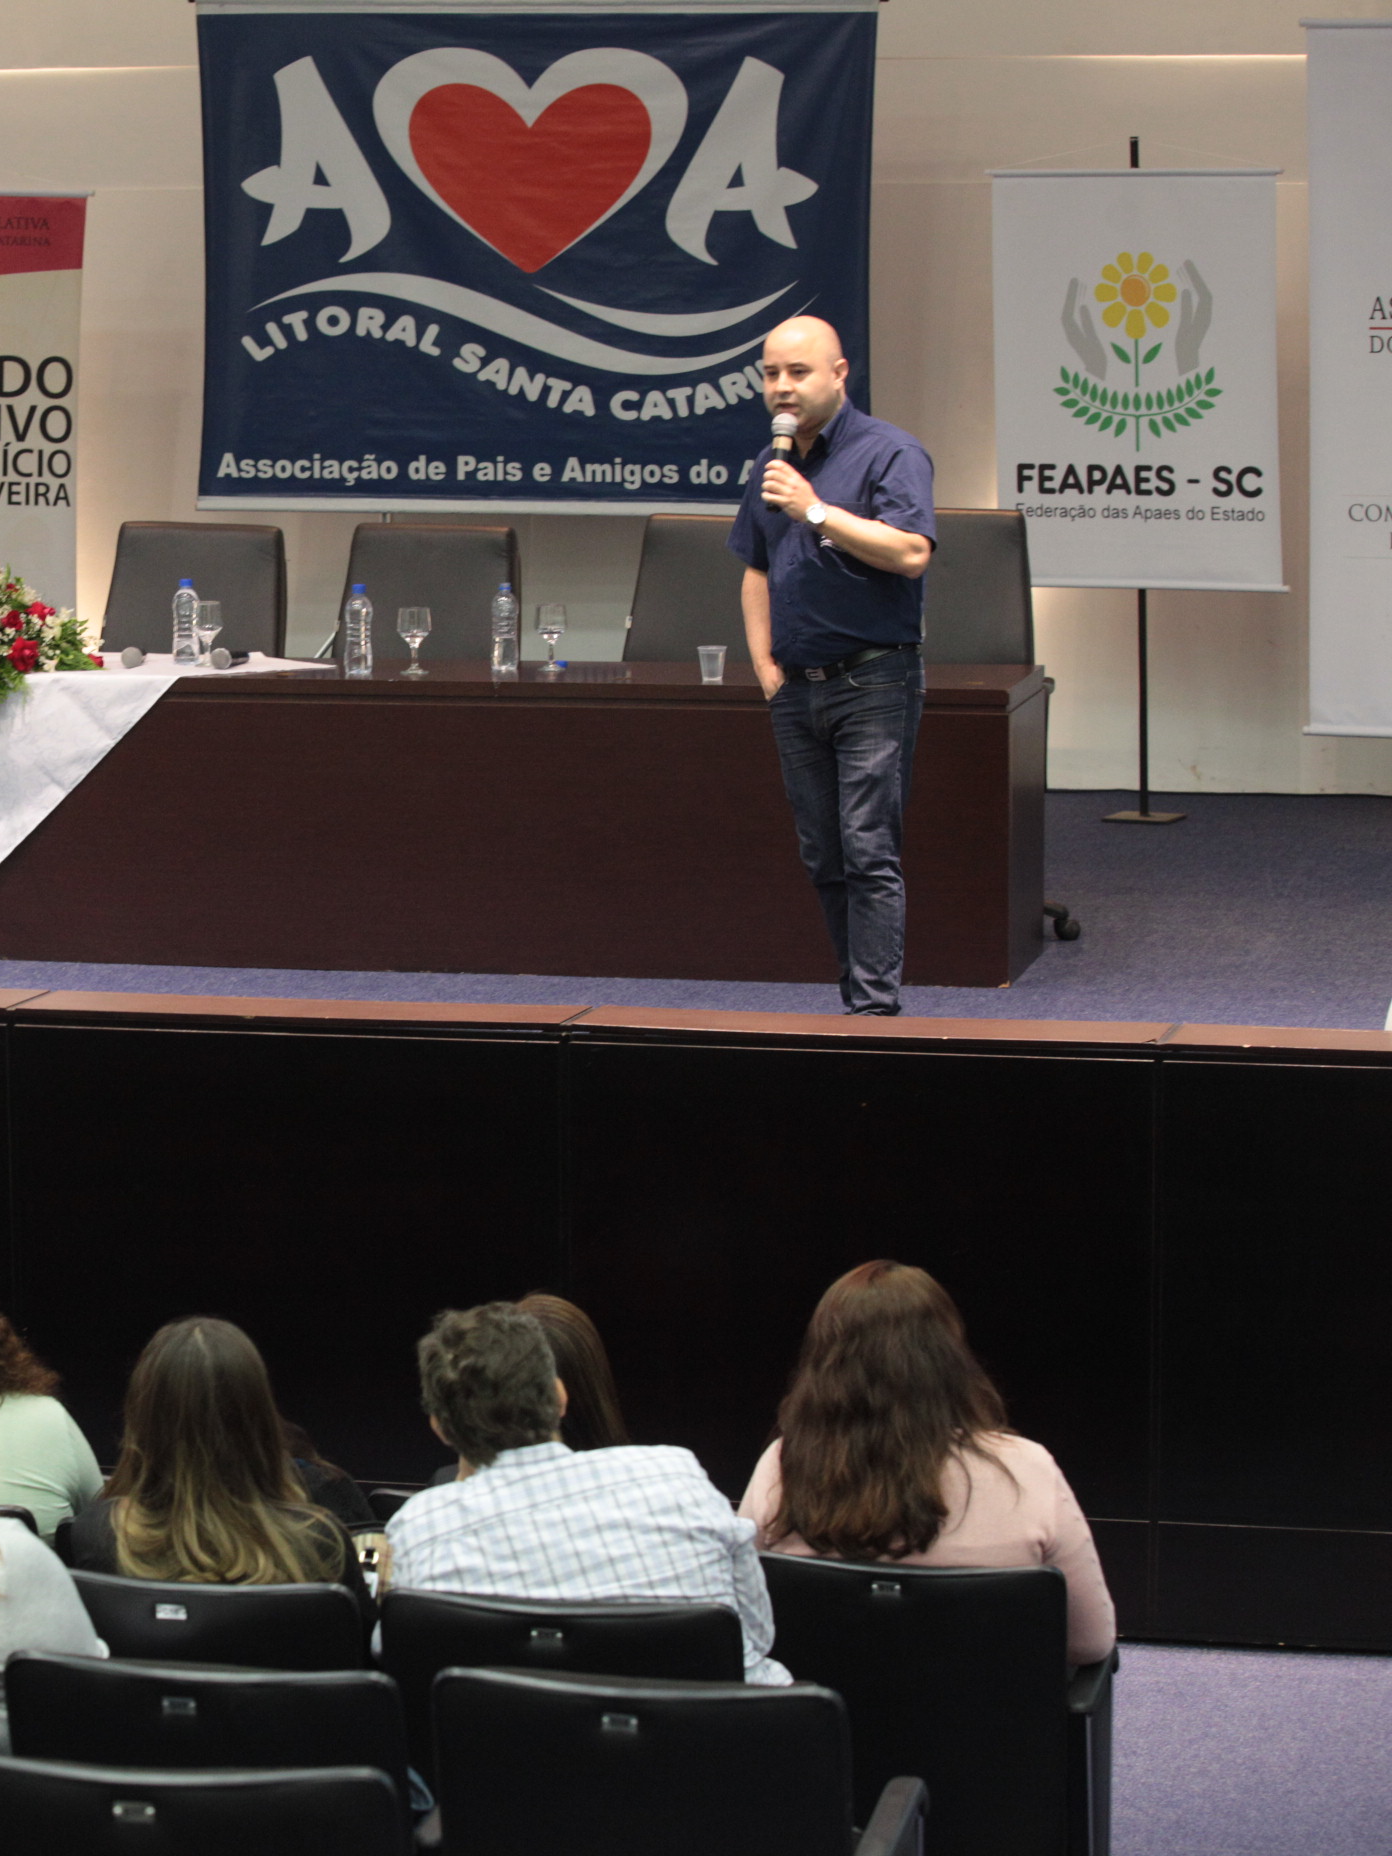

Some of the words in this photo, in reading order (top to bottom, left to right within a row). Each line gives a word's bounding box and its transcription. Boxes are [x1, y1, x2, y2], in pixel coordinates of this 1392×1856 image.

[240, 55, 392, 263] A
[665, 56, 819, 266] A
[241, 305, 441, 362] LITORAL
[453, 343, 596, 417] SANTA
[610, 358, 764, 421] CATARI
[216, 452, 399, 486] Associação
[408, 455, 447, 481] de
[456, 455, 523, 481] Pais
[532, 461, 552, 482] e
[561, 456, 680, 490] Amigos
[689, 458, 729, 485] do
[1016, 463, 1176, 497] FEAPAES
[1211, 466, 1264, 498] SC
[1101, 505, 1129, 520] das
[1132, 505, 1181, 522] Apaes
[1185, 506, 1206, 521] do
[1211, 506, 1265, 522] Estado
